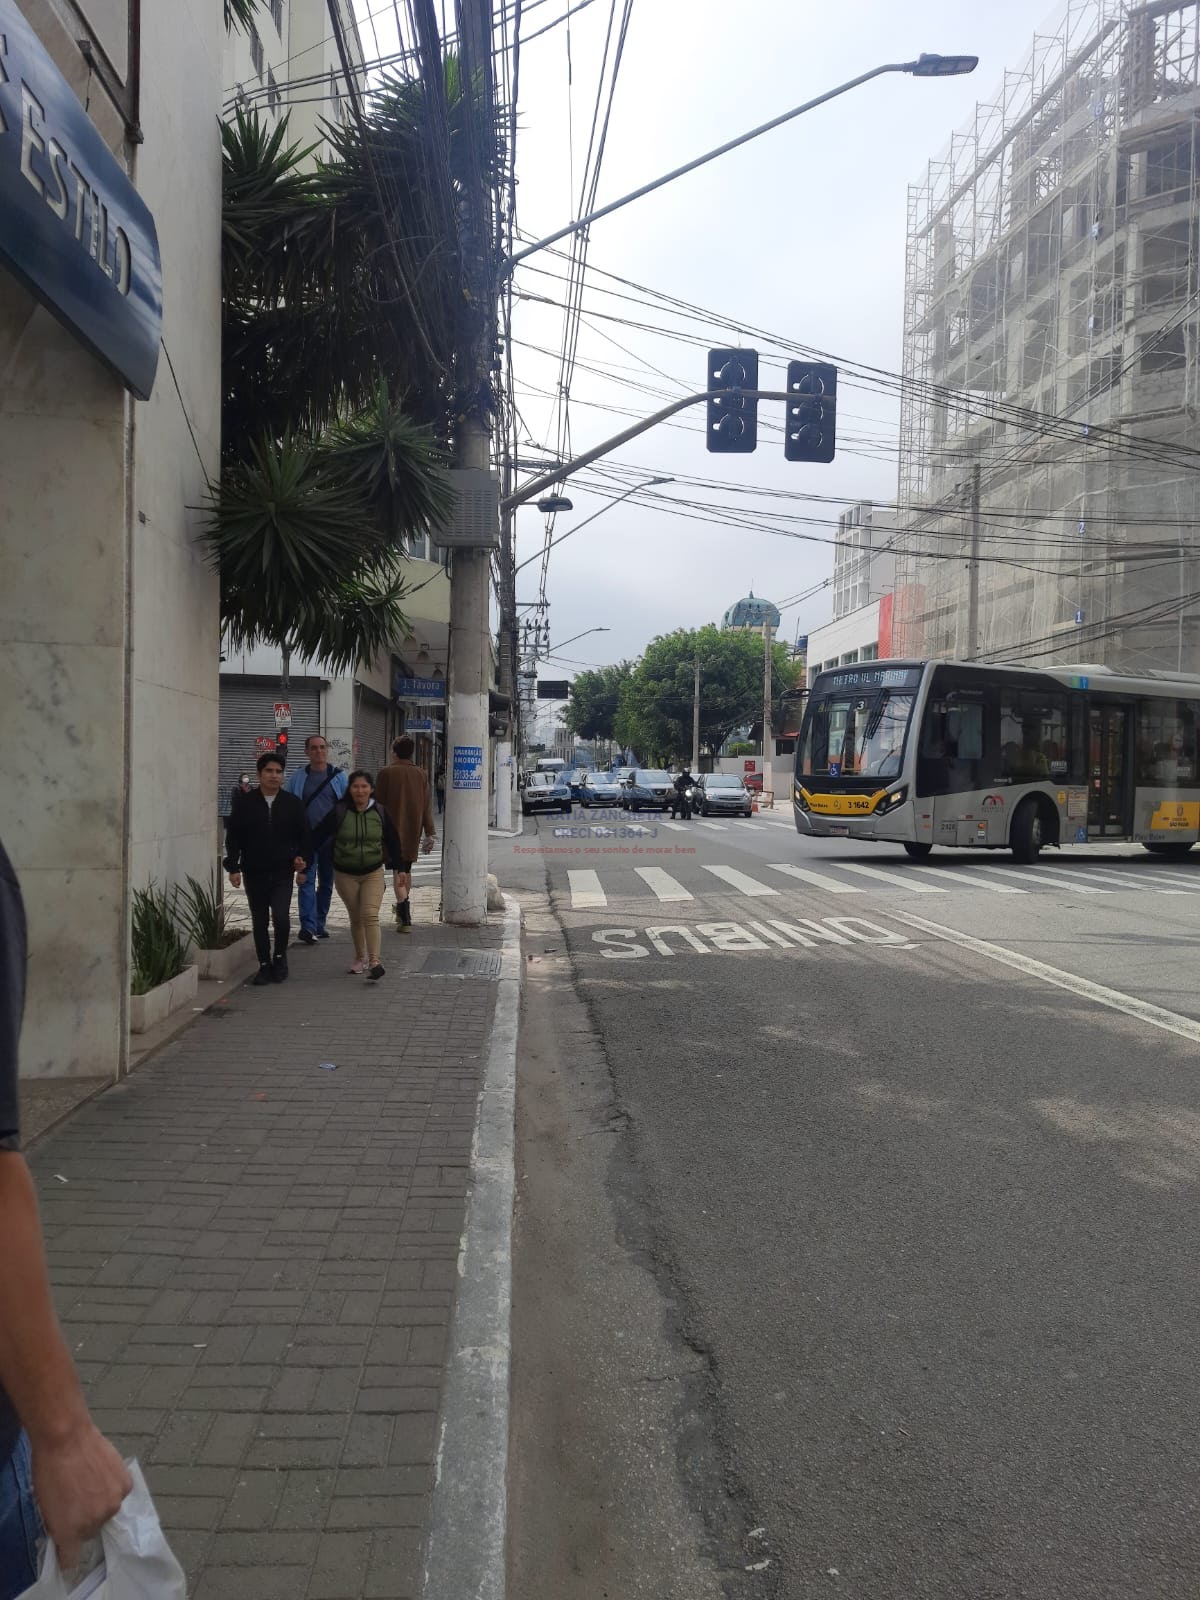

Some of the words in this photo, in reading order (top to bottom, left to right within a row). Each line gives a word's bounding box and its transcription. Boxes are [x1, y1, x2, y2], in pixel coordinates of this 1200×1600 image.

[21, 78, 132, 297] ESTILO
[833, 673, 859, 686] METRO
[856, 701, 865, 710] 3
